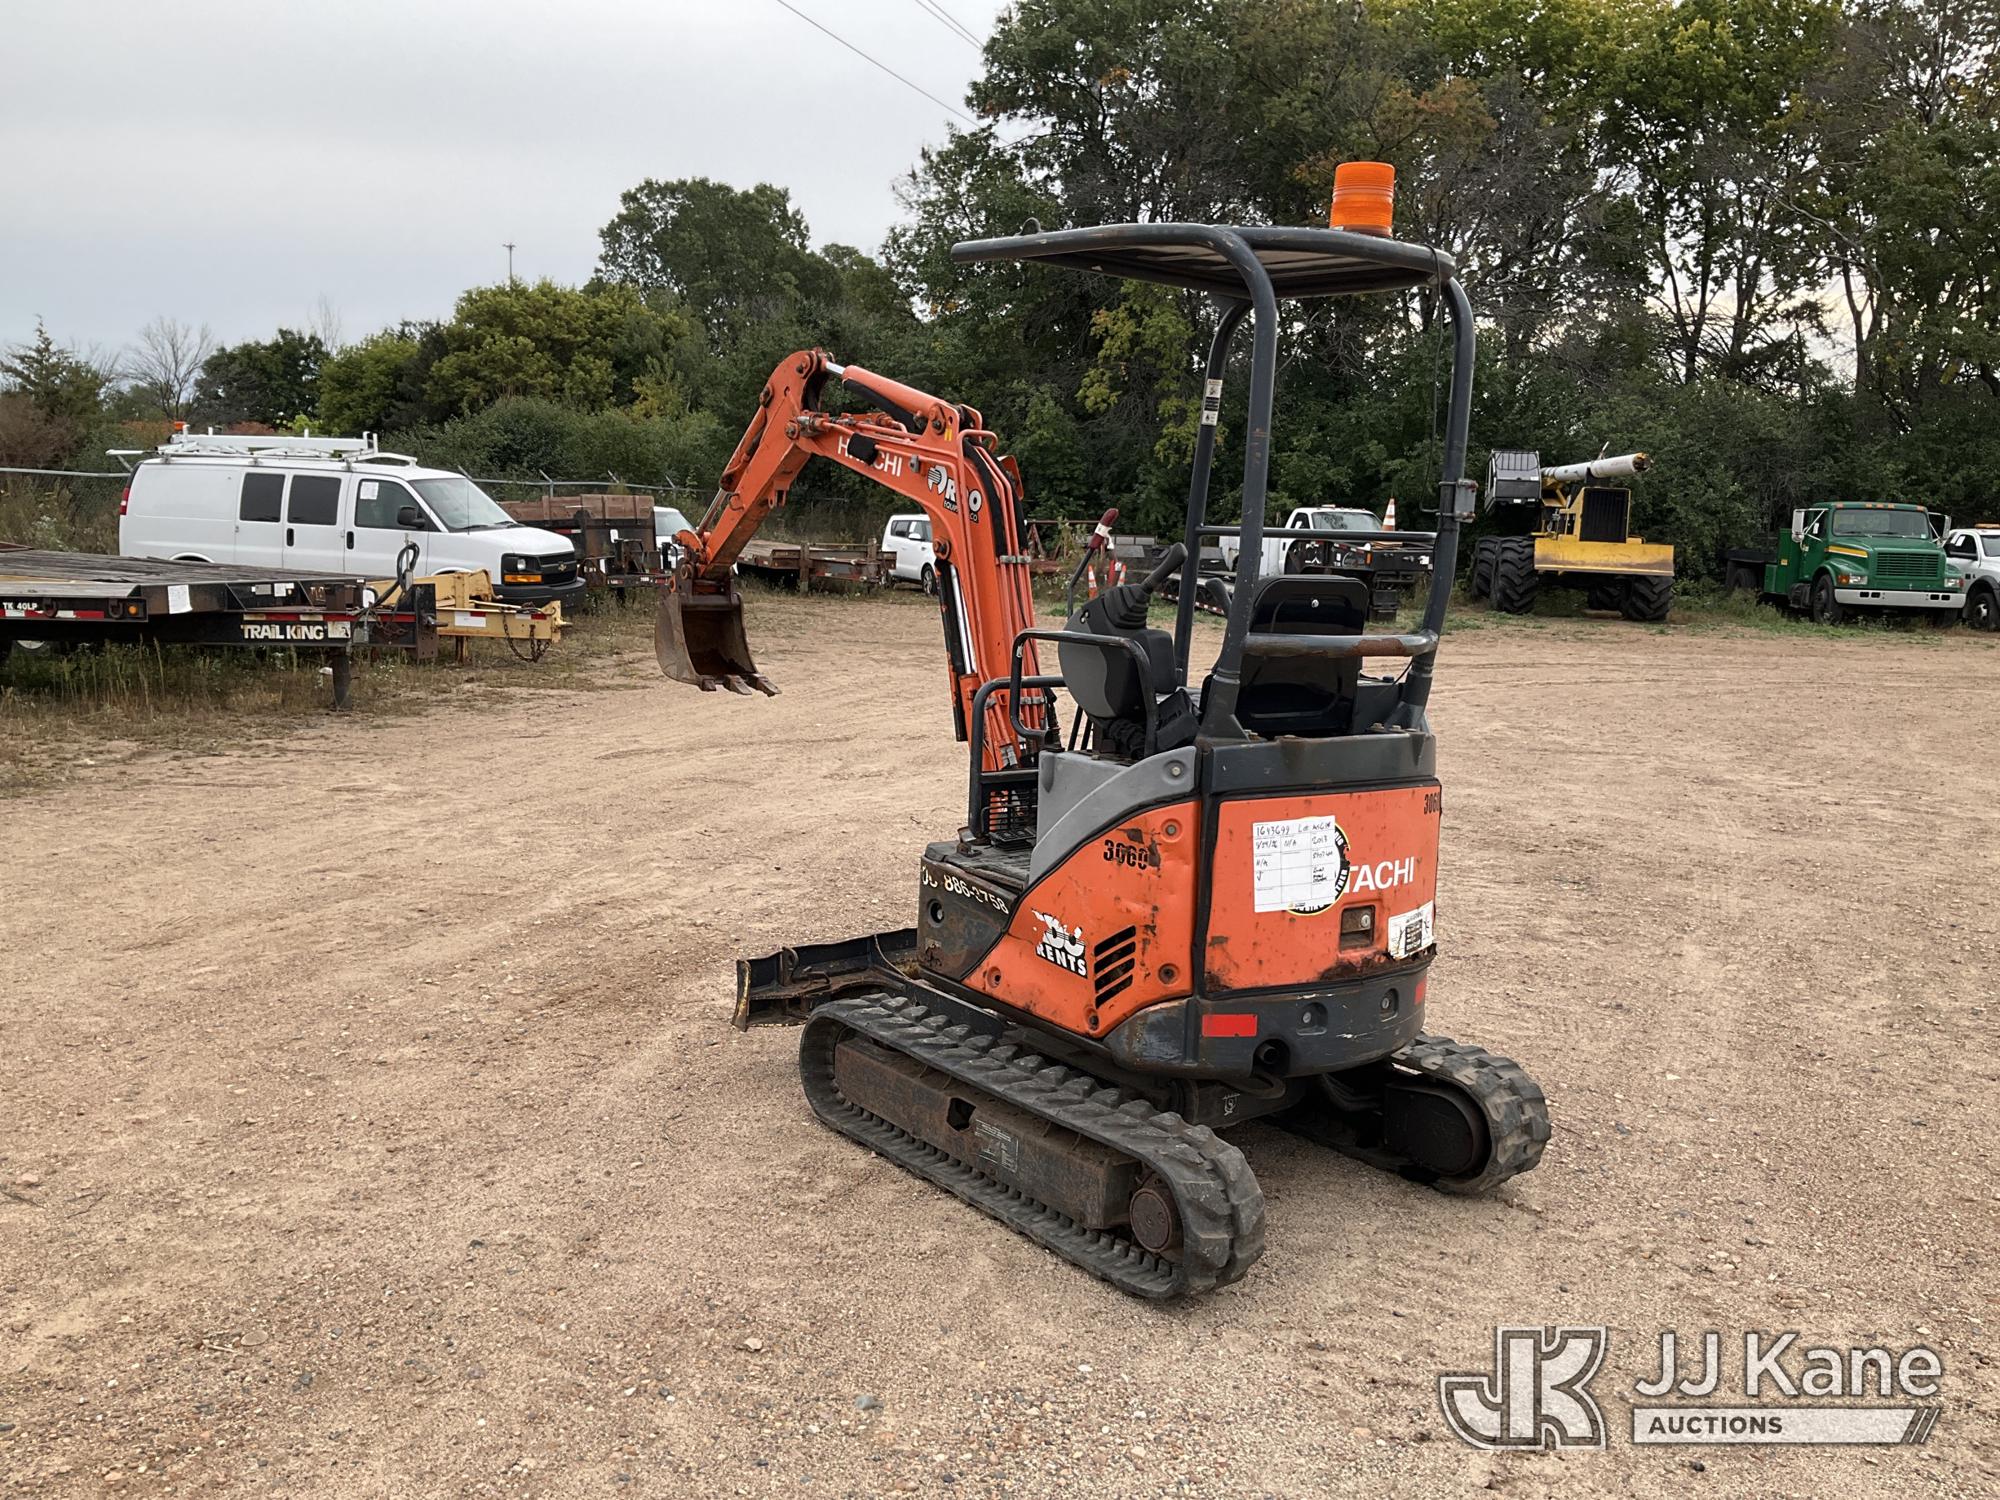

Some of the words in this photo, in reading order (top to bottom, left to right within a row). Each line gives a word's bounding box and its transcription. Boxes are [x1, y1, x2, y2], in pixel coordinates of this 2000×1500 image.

[838, 436, 902, 477] HCHI
[1103, 839, 1149, 870] 3060
[1342, 856, 1415, 894] TACHI
